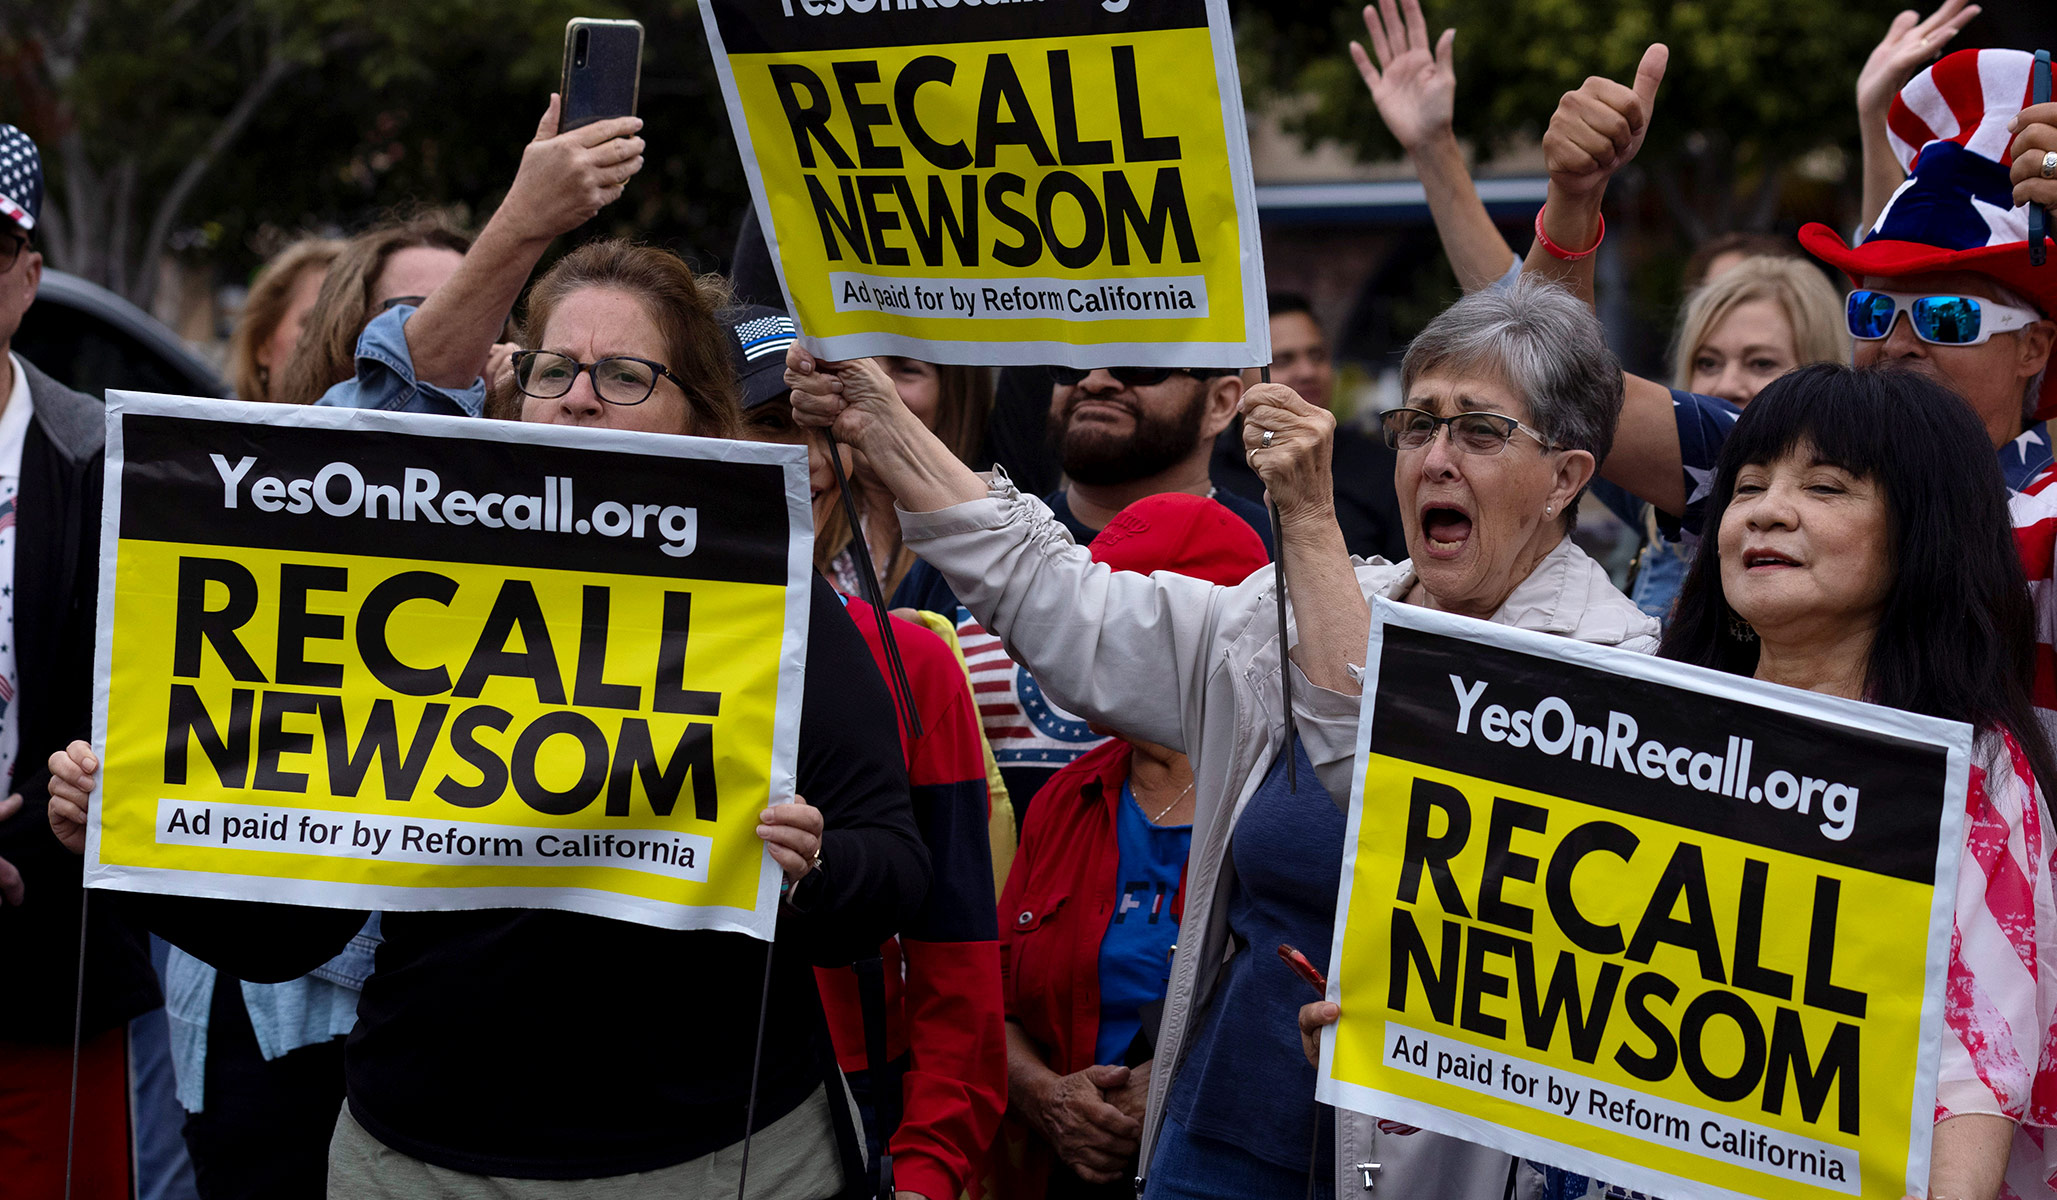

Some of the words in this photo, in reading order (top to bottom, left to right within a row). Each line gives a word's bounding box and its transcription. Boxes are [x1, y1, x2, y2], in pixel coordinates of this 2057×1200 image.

[767, 45, 1182, 170] RECALL
[803, 167, 1201, 269] NEWSOM
[843, 280, 872, 304] Ad
[872, 285, 911, 312] paid
[914, 285, 945, 311] for
[950, 285, 976, 318] by
[982, 285, 1065, 312] Reform
[1067, 284, 1197, 313] California
[210, 453, 698, 558] YesOnRecall.org
[173, 556, 721, 716] RECALL
[164, 684, 718, 822] NEWSOM
[1450, 673, 1860, 841] YesOnRecall.org
[167, 808, 211, 836] Ad
[222, 813, 289, 844] paid
[298, 815, 343, 845] for
[352, 820, 392, 856] by
[401, 825, 524, 857] Reform
[535, 834, 695, 869] California
[1114, 881, 1180, 925] FI
[1396, 777, 1867, 1019] RECALL
[1387, 907, 1860, 1136] NEWSOM
[1391, 1034, 1428, 1068] Ad
[1436, 1052, 1493, 1086] paid
[1501, 1063, 1539, 1098] for
[1547, 1075, 1581, 1116] by
[1588, 1088, 1690, 1142] Reform
[1700, 1120, 1847, 1183] California
